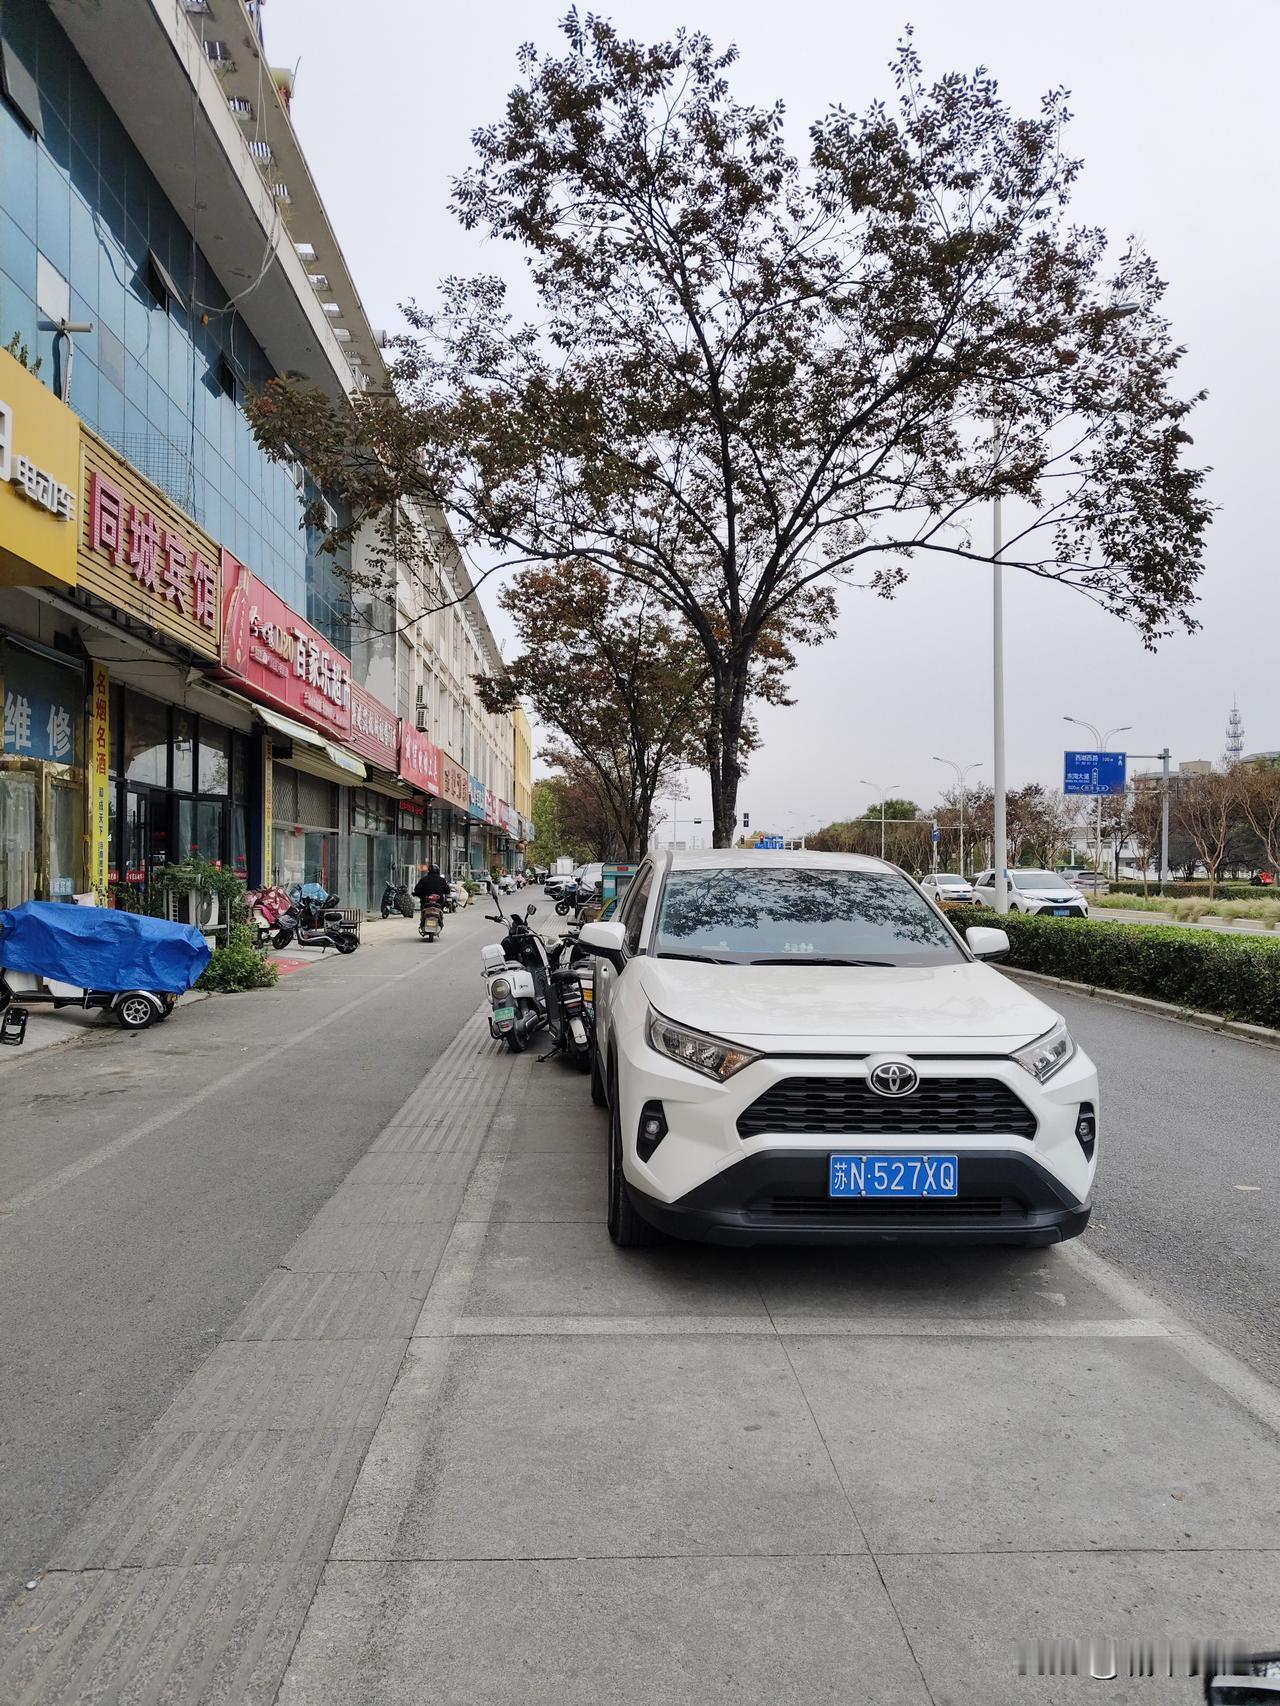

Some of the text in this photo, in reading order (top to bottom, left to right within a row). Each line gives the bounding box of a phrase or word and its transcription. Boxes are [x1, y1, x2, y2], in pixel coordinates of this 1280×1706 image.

[16, 455, 77, 522] 电动车
[89, 471, 216, 630] 同城宾馆
[290, 626, 351, 711] 百家乐超市
[3, 691, 73, 759] 维修
[95, 671, 107, 777] 名烟名酒
